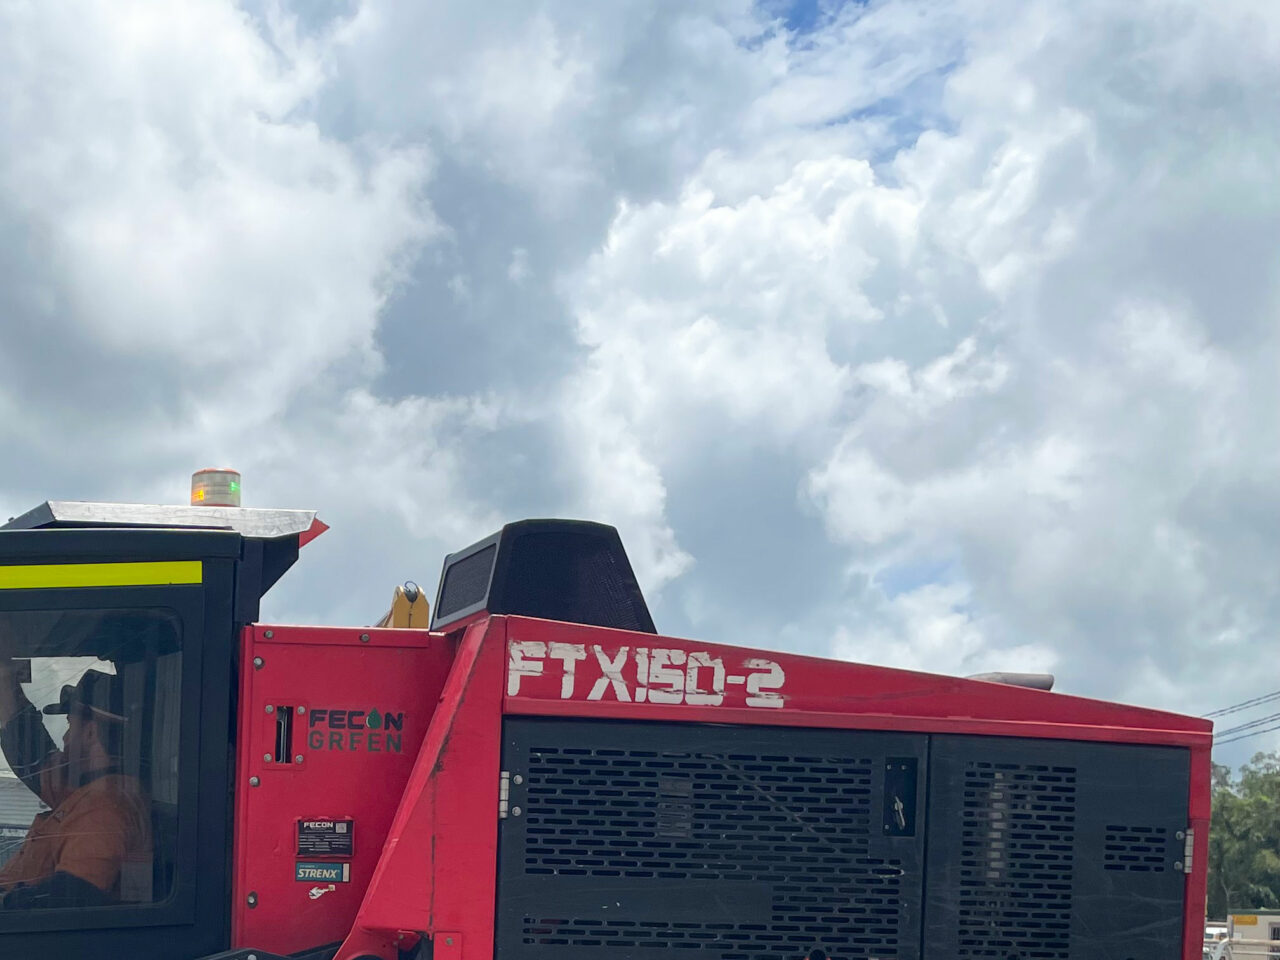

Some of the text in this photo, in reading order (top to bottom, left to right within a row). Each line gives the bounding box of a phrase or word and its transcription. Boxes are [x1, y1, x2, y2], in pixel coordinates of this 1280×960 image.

[508, 640, 786, 708] FTX150-2
[309, 707, 404, 731] FECON
[309, 730, 402, 752] GREEN
[298, 868, 338, 878] STRENX
